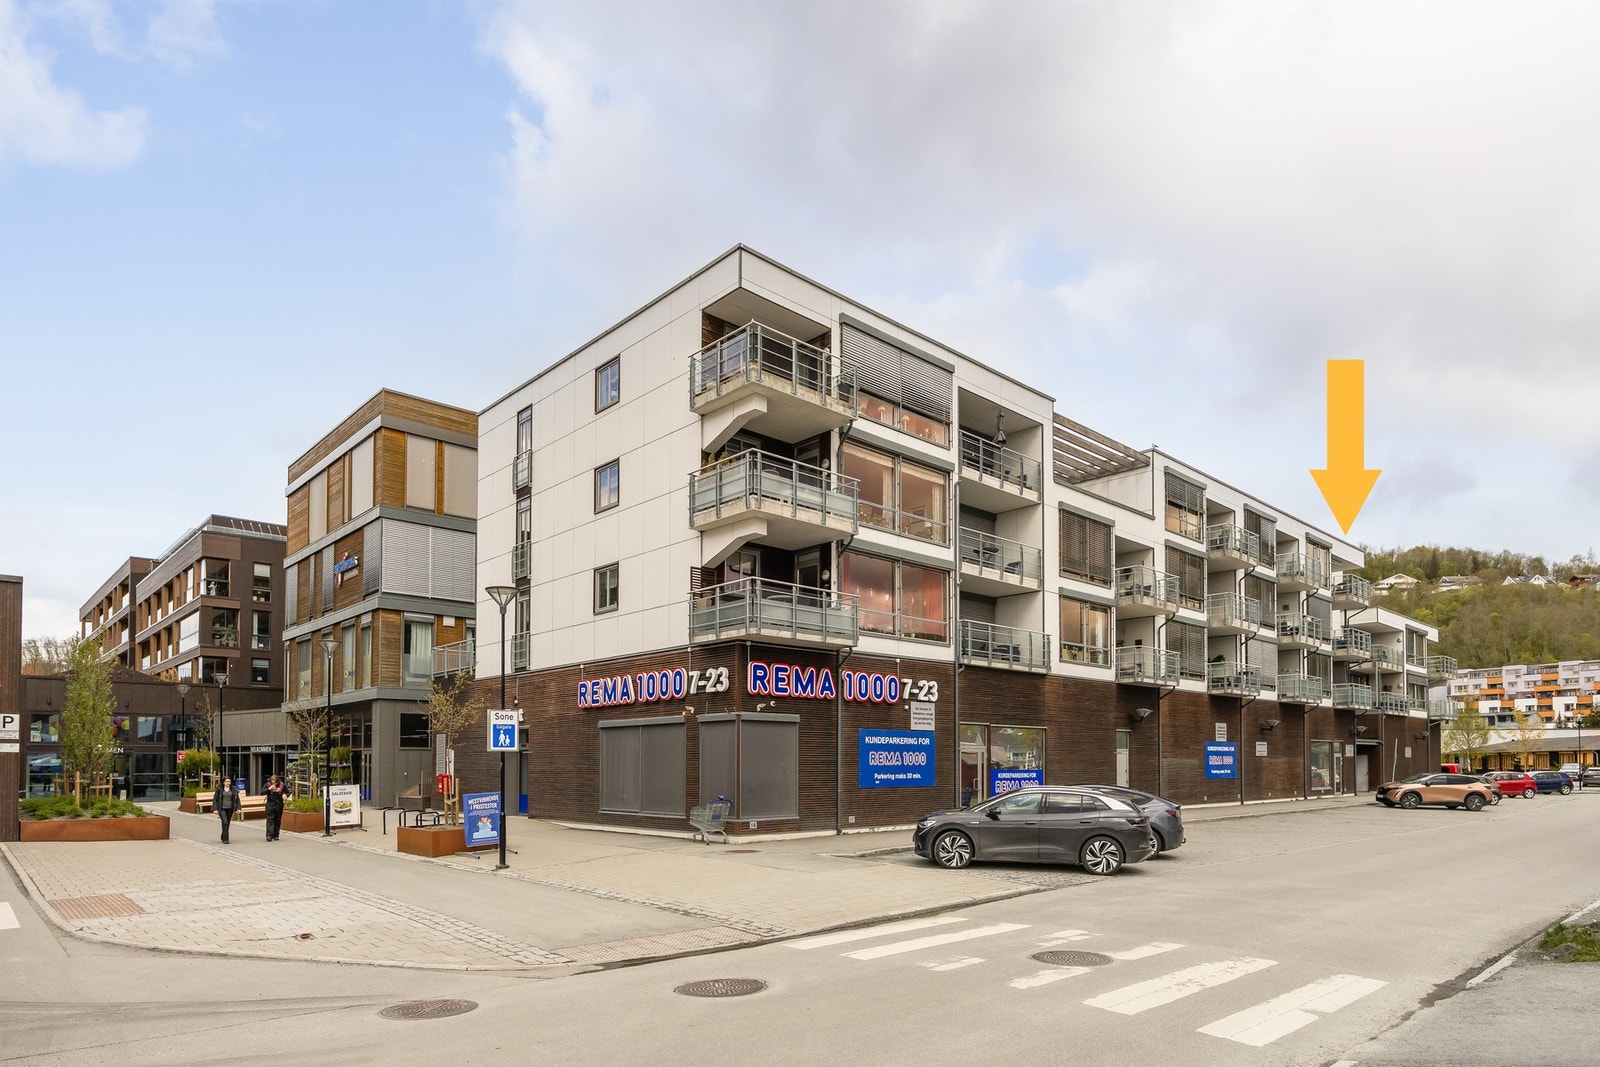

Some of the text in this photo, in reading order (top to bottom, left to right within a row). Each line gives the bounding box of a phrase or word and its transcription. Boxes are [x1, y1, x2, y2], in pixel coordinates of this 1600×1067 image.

[578, 667, 688, 708] REMA 1000
[688, 667, 729, 694] 7-23
[748, 661, 900, 704] REMA 1000
[901, 678, 939, 702] 7-23
[3, 715, 14, 728] P
[494, 712, 514, 721] Sone
[865, 736, 930, 745] KUNDEPARKERING FOR
[869, 751, 927, 766] REMA 1000
[1209, 755, 1223, 765] REMA
[995, 780, 1020, 794] REMA
